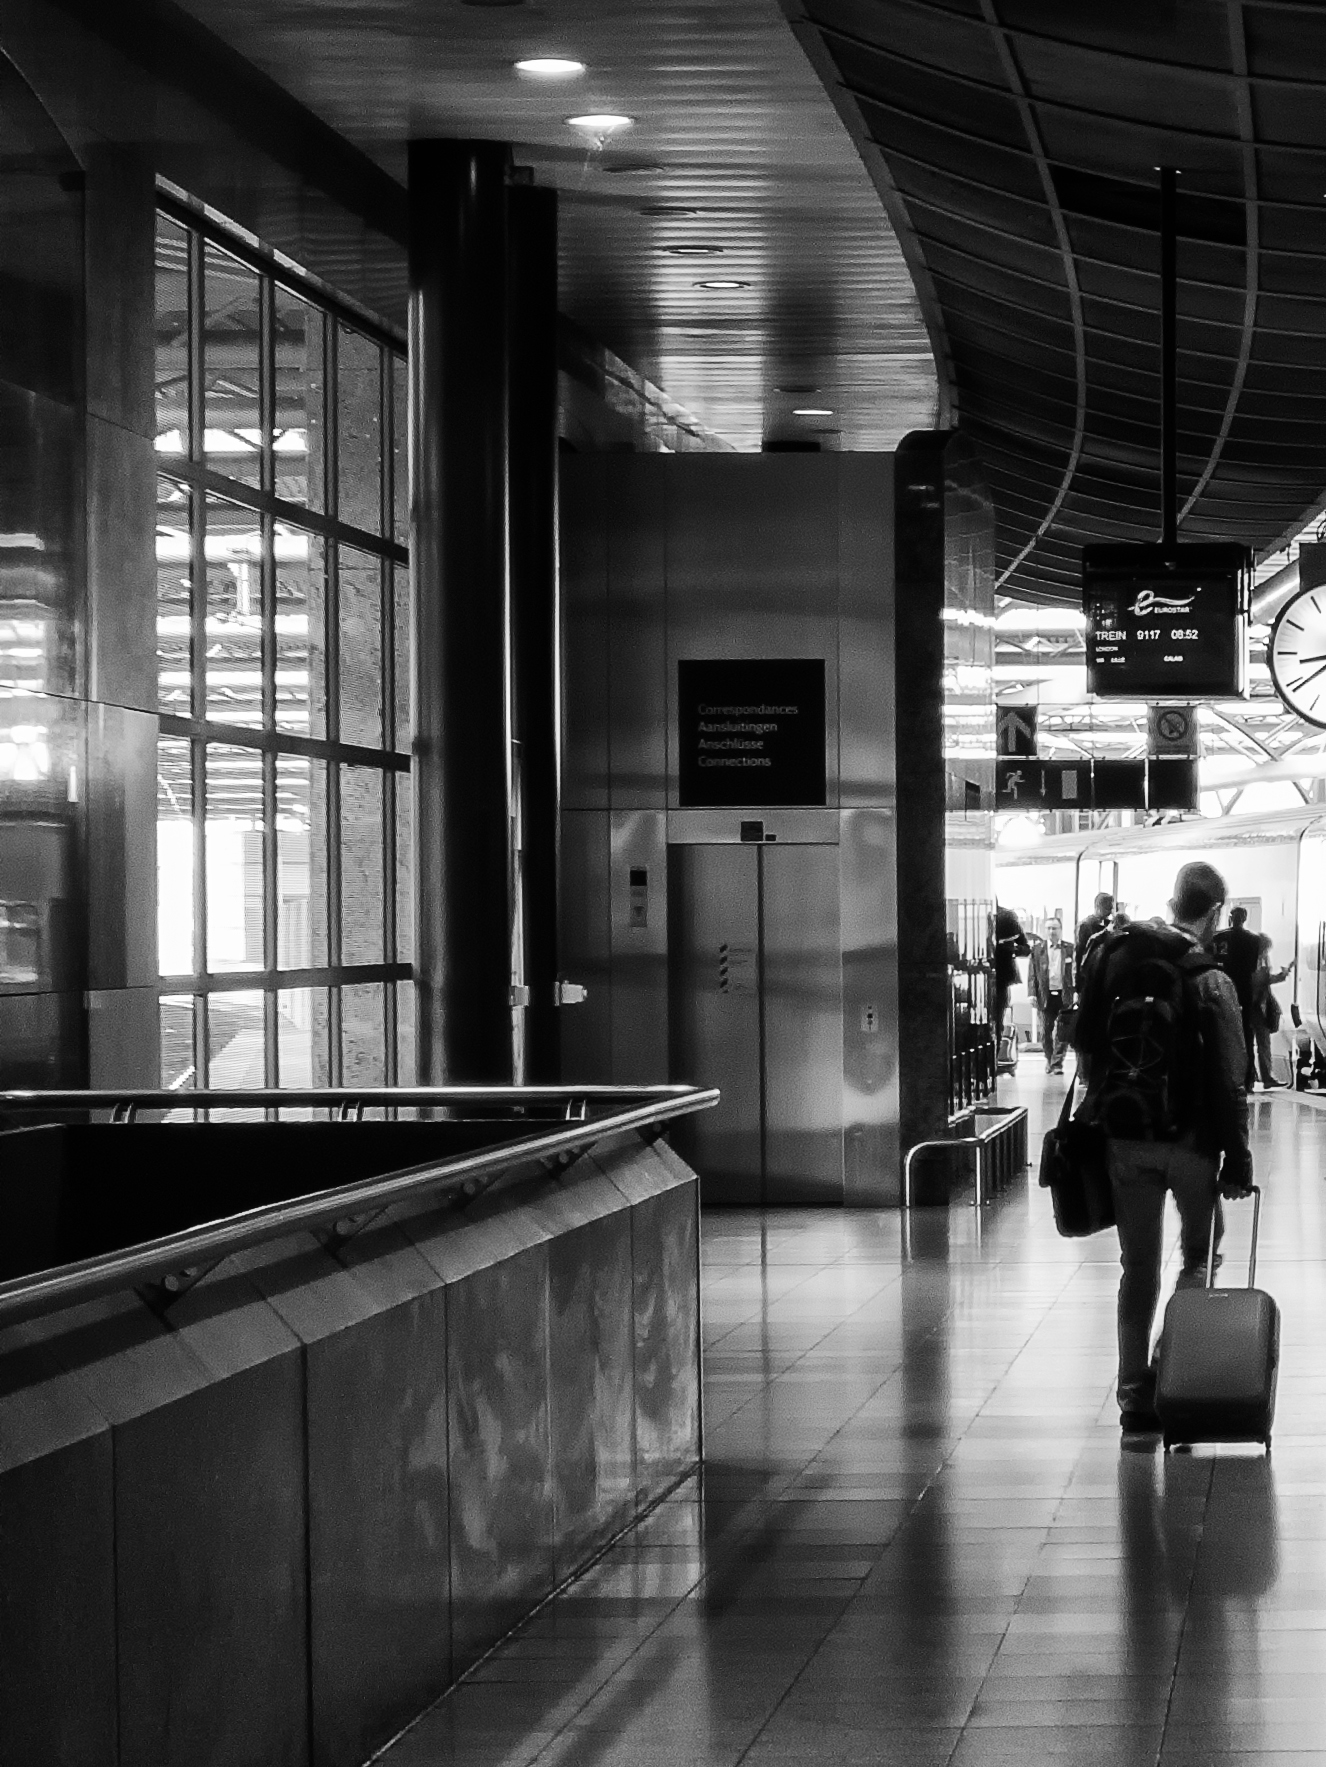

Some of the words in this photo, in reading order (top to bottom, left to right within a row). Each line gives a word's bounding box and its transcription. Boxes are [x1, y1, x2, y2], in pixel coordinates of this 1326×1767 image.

[1095, 630, 1127, 641] TREIN
[698, 703, 799, 716] Correspondances
[698, 720, 778, 734] Aansluitingen
[698, 737, 764, 750] Anschlüsse
[698, 755, 772, 767] Connections
